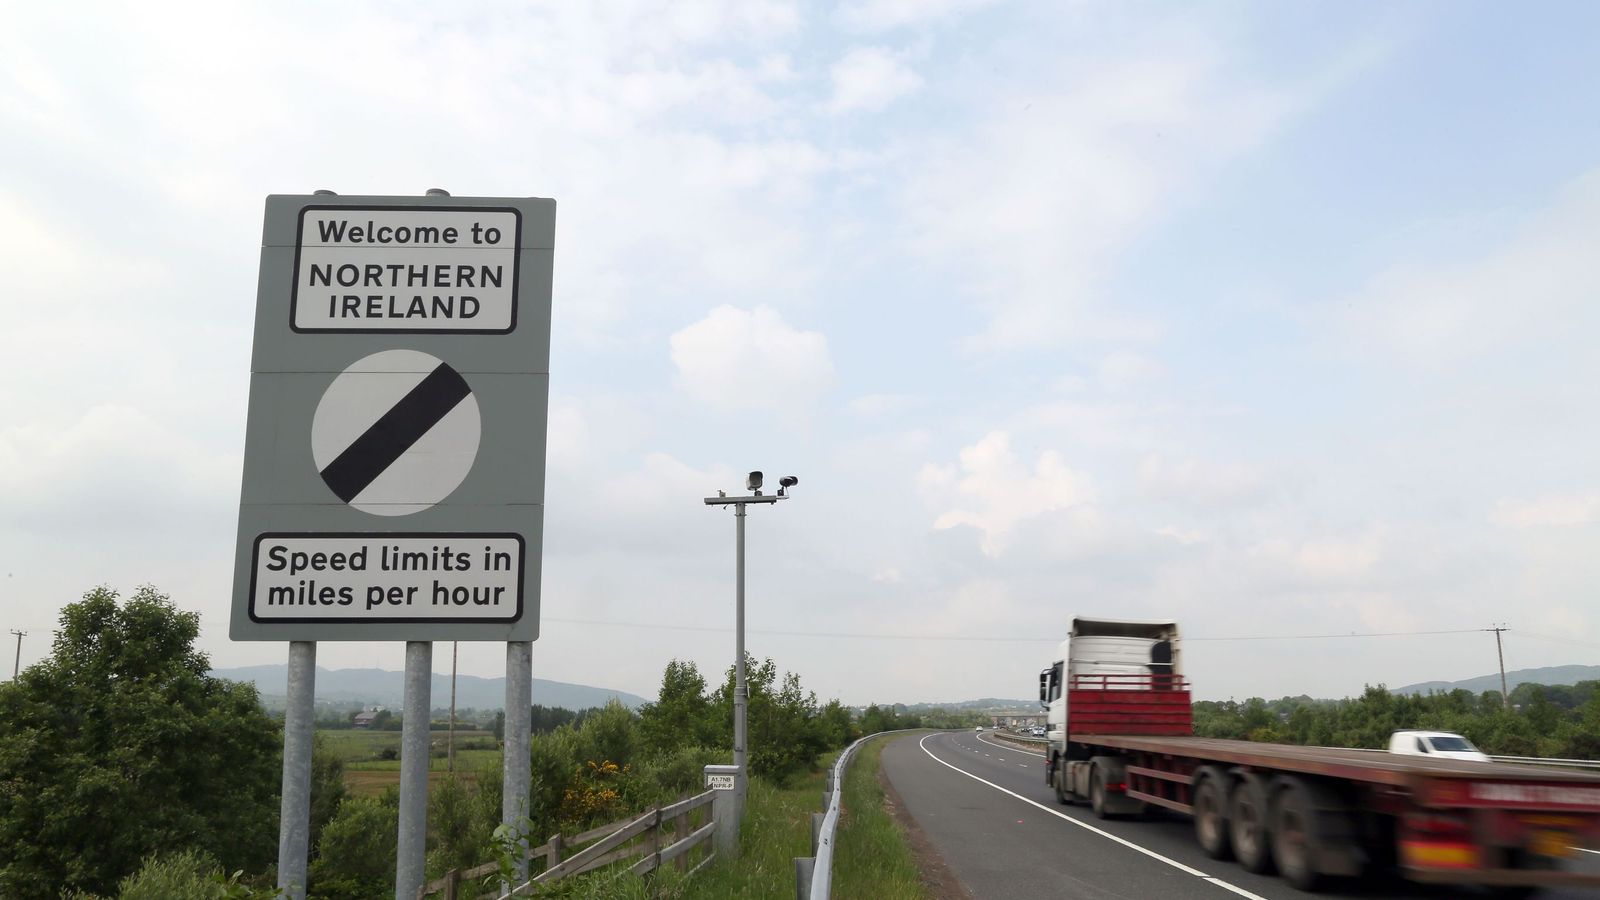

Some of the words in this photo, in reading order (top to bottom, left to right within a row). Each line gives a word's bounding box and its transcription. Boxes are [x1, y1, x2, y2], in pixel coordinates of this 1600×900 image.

[318, 220, 458, 245] Welcome
[471, 222, 502, 245] to
[309, 263, 503, 288] NORTHERN
[329, 295, 481, 319] IRELAND
[265, 545, 368, 576] Speed
[381, 545, 471, 572] limits
[484, 545, 512, 571] in
[267, 579, 354, 606] miles
[365, 585, 419, 611] per
[431, 579, 506, 606] hour
